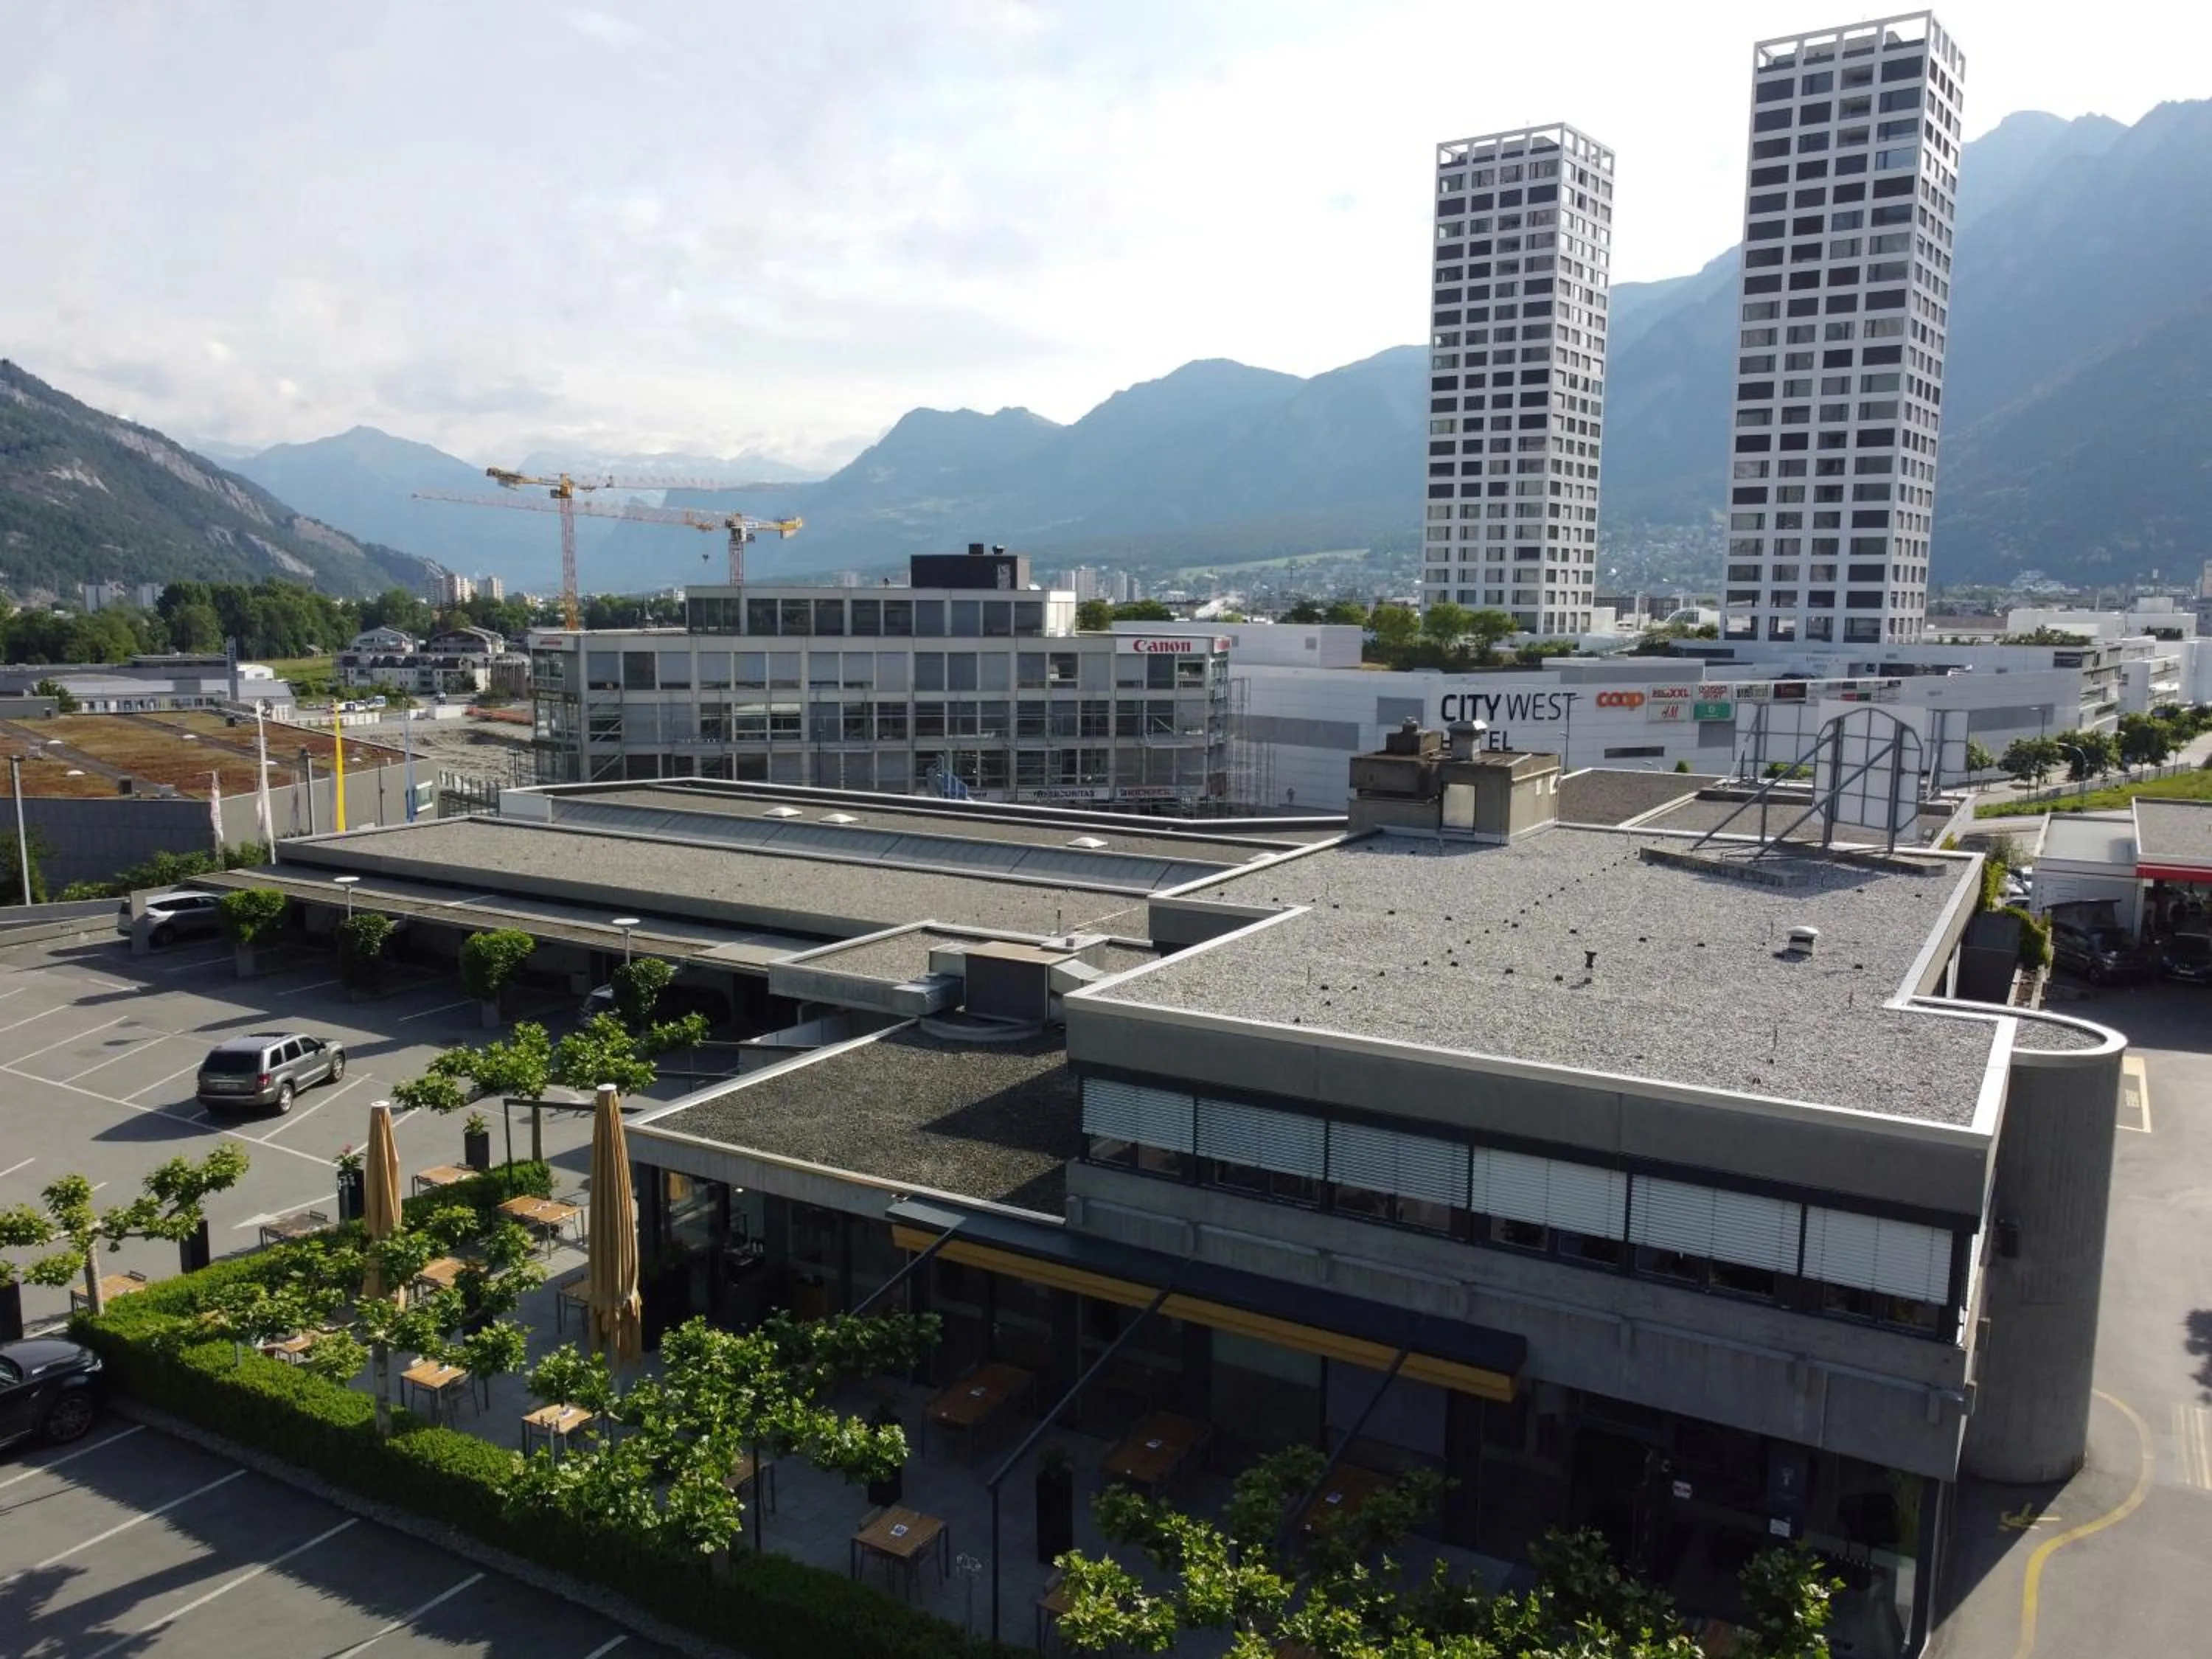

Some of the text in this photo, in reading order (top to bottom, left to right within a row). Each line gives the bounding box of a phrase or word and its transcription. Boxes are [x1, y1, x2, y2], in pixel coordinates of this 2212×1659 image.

[1133, 639, 1192, 653] Canon
[1441, 692, 1577, 722] CITY WEST
[1596, 691, 1645, 710] coop
[1440, 731, 1513, 751] HEL
